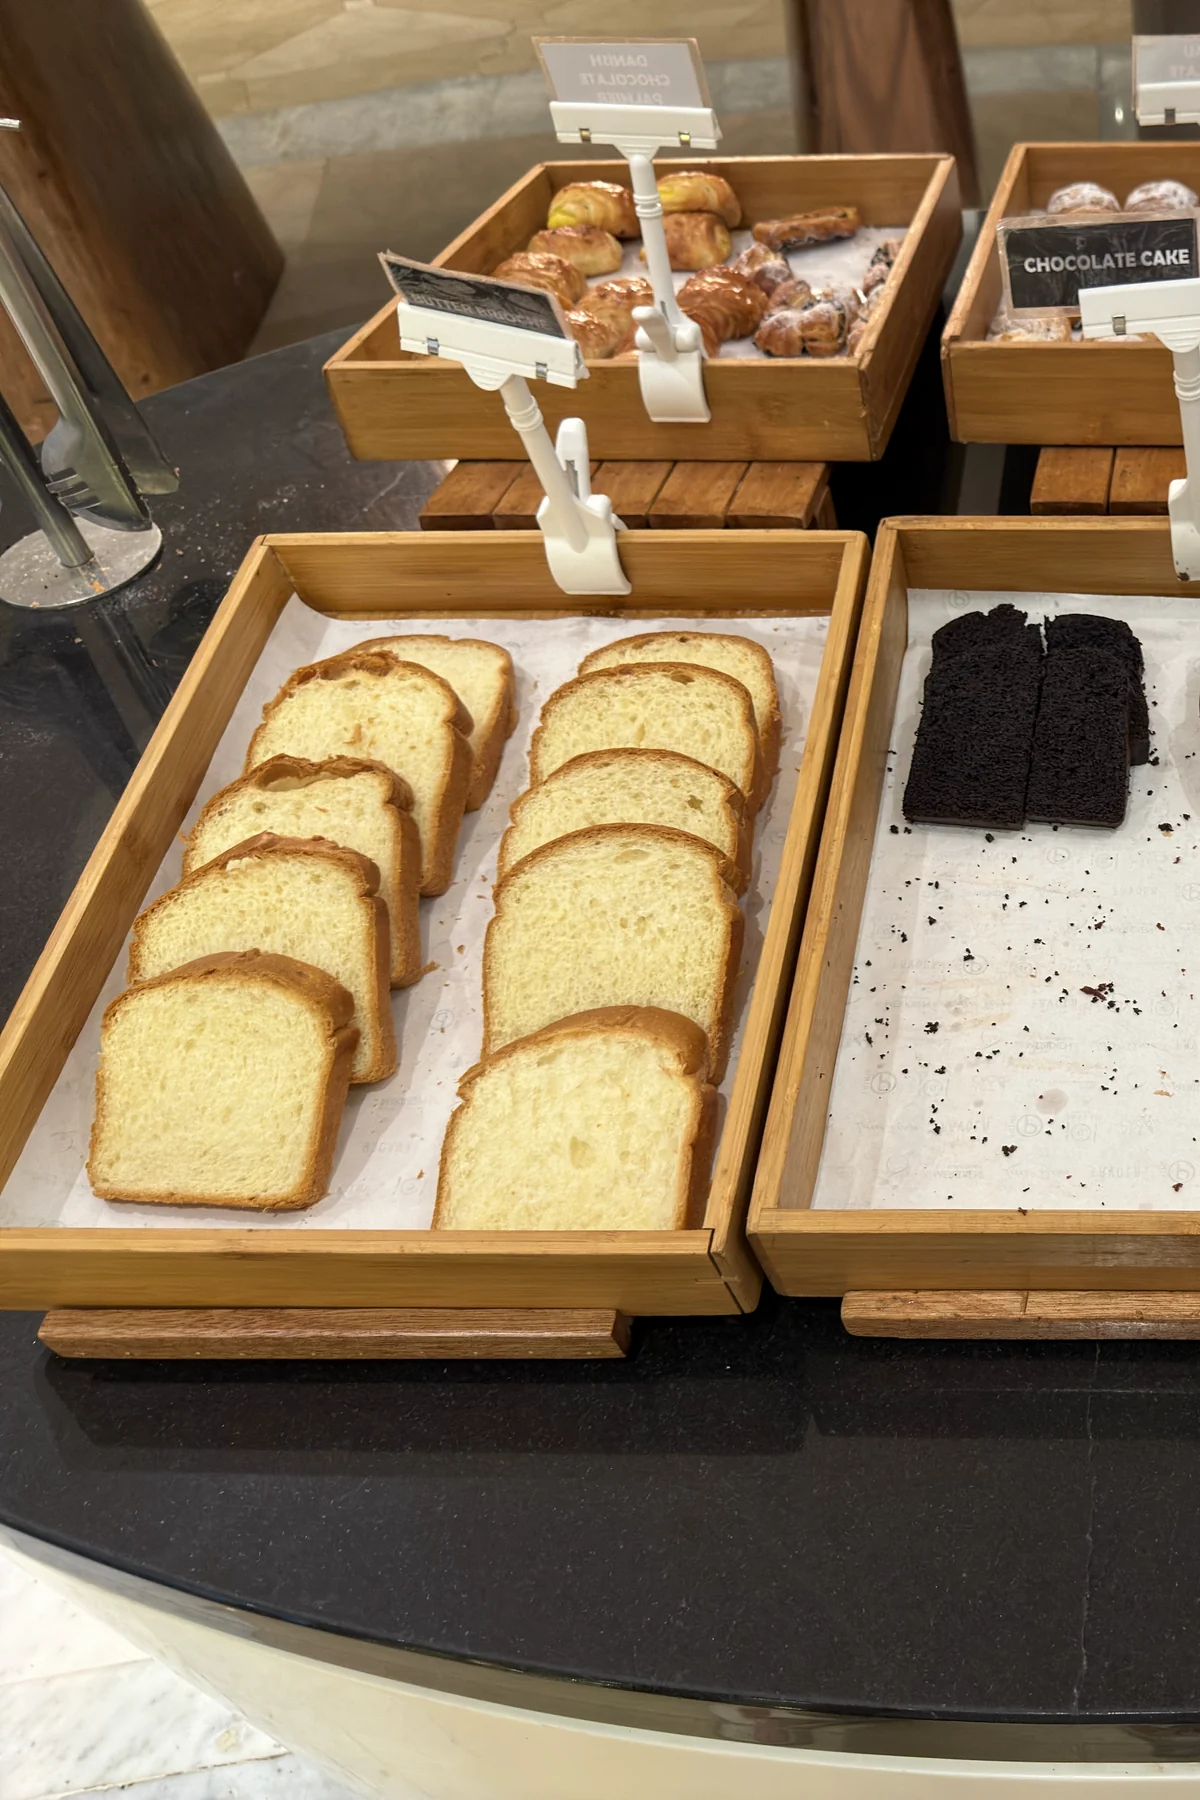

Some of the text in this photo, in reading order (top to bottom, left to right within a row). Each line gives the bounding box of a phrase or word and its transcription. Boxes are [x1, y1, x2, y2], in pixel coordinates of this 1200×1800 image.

[1023, 248, 1190, 274] CHOCOLATE CAKE
[409, 292, 474, 314] BUTTER
